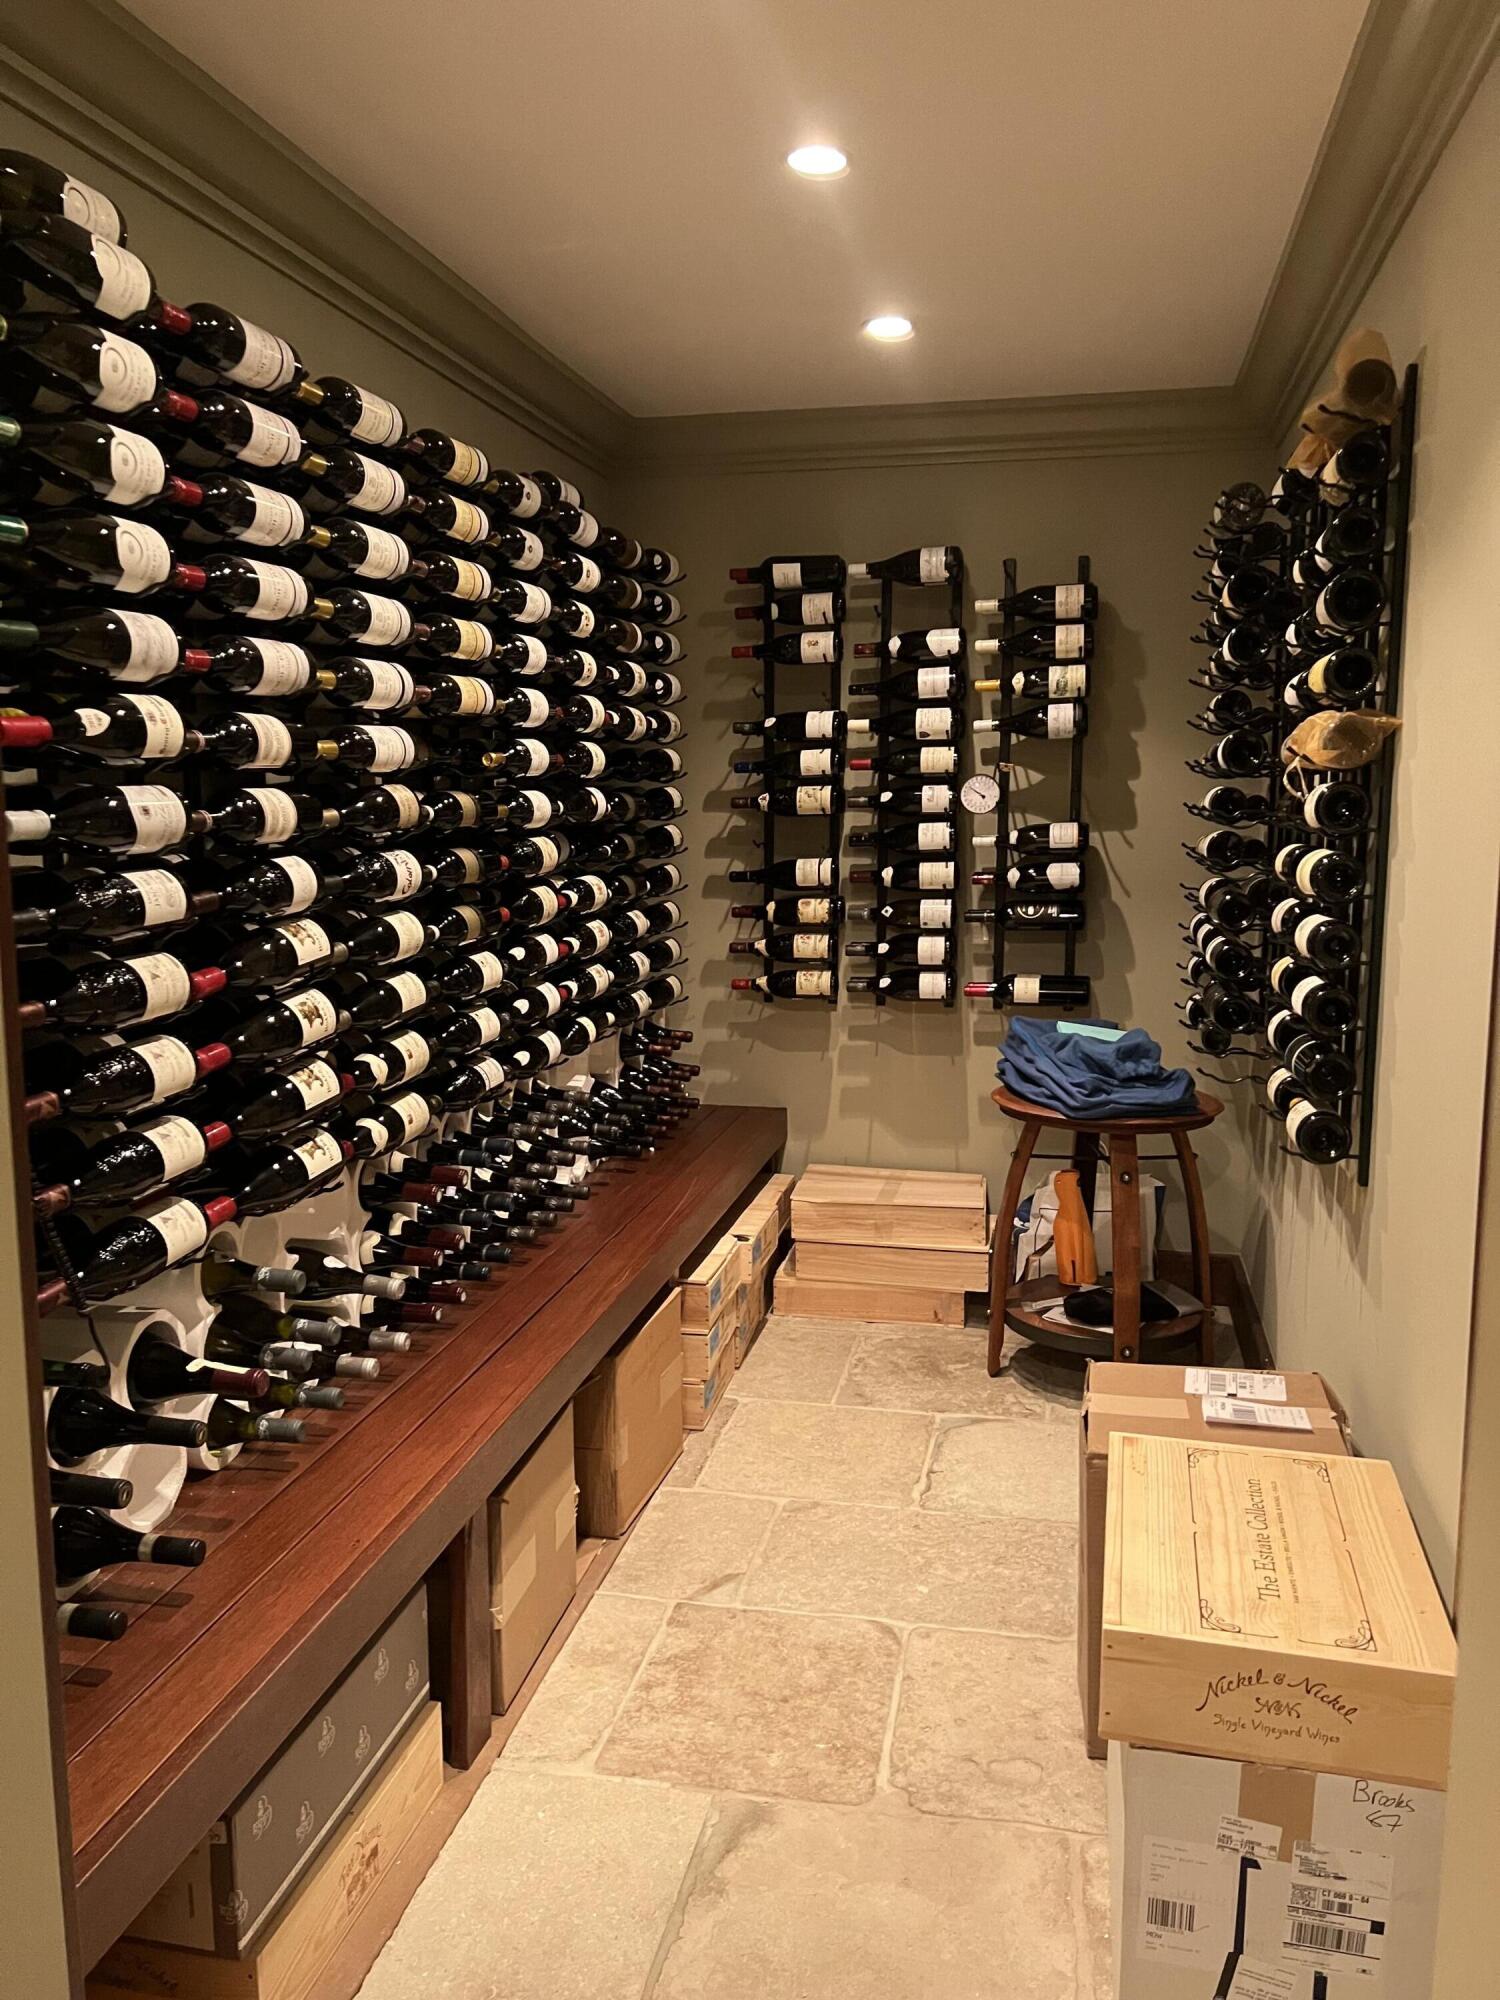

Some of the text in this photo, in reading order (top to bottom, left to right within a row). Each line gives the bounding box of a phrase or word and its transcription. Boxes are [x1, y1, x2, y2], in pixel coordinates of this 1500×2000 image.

[1244, 1478, 1281, 1600] The Estate Collection
[1195, 1668, 1269, 1712] Nickel
[1287, 1676, 1359, 1725] Nickel
[1213, 1713, 1341, 1746] Single Vineyard Wines
[1352, 1779, 1416, 1813] Brooks
